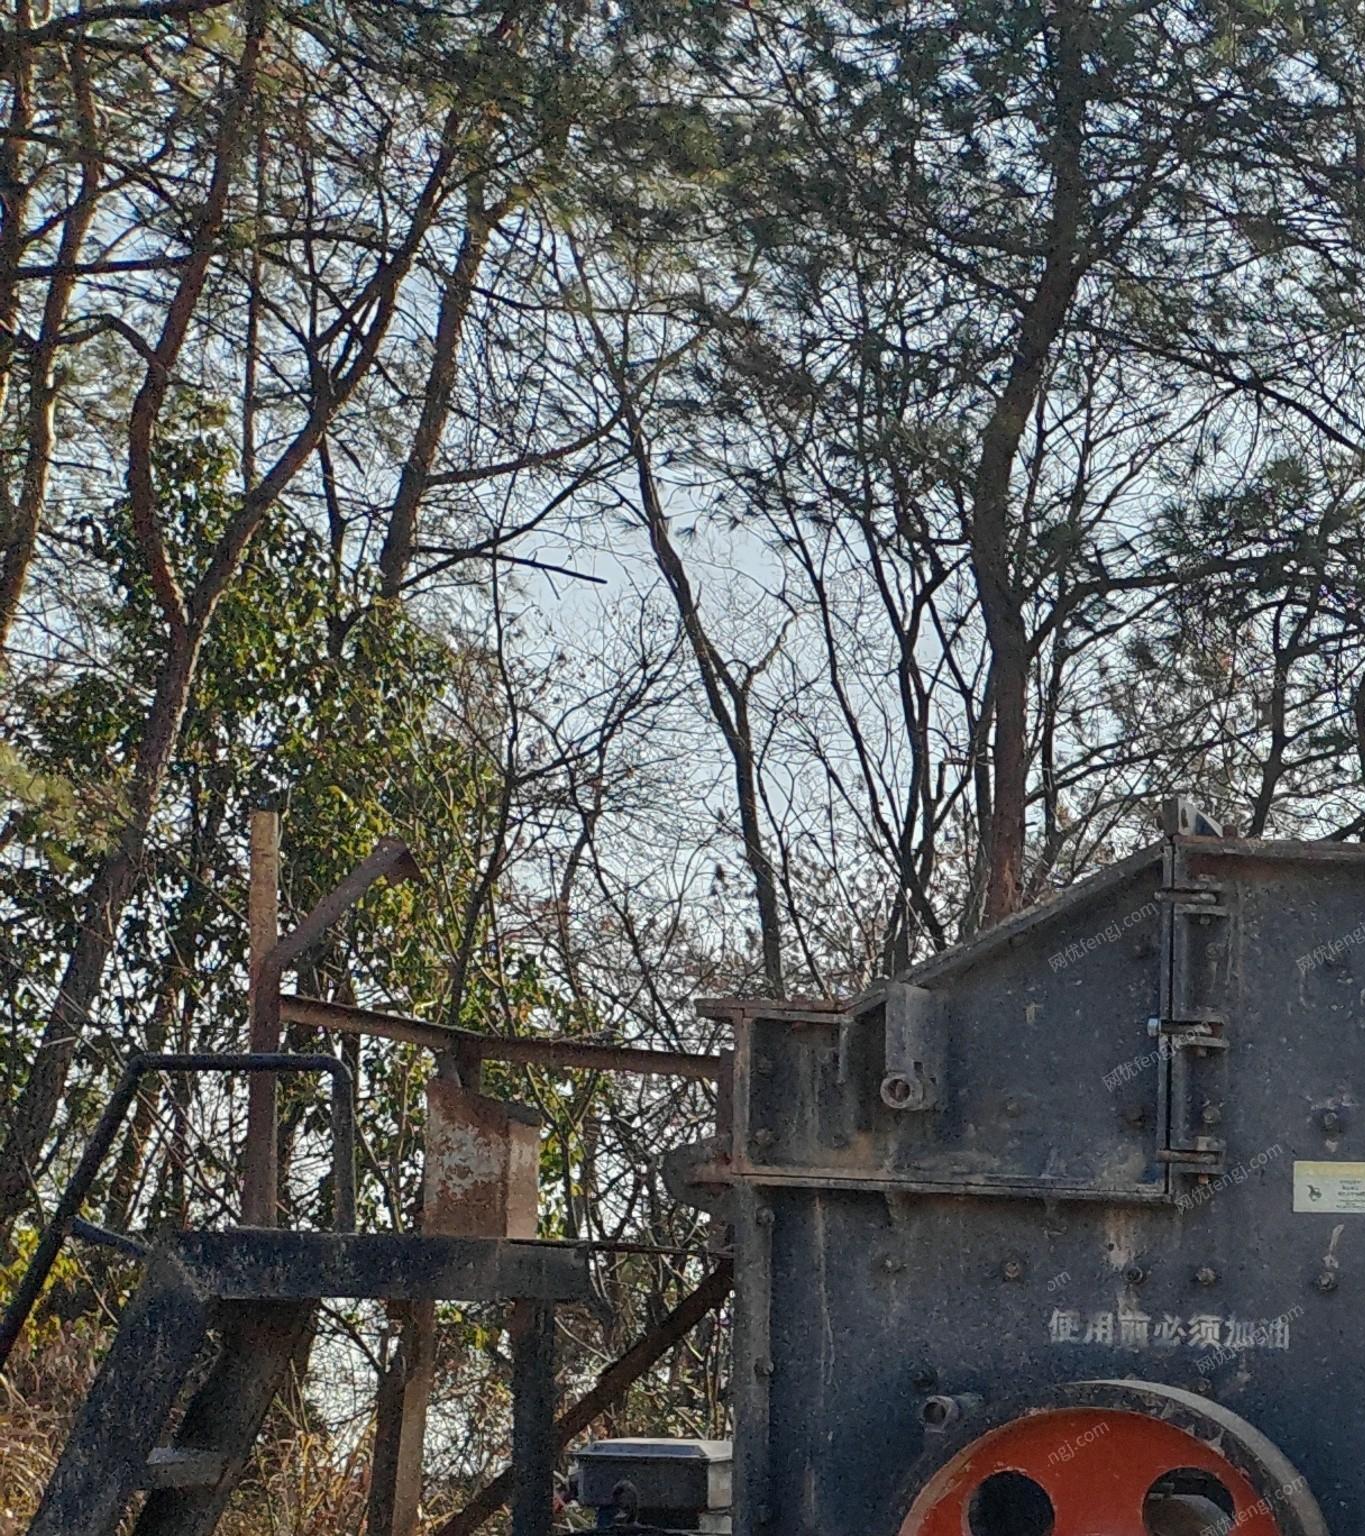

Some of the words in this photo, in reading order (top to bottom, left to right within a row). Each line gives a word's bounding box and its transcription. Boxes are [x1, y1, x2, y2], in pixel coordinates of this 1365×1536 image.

[1049, 1307, 1290, 1351] 使用前必须加油
